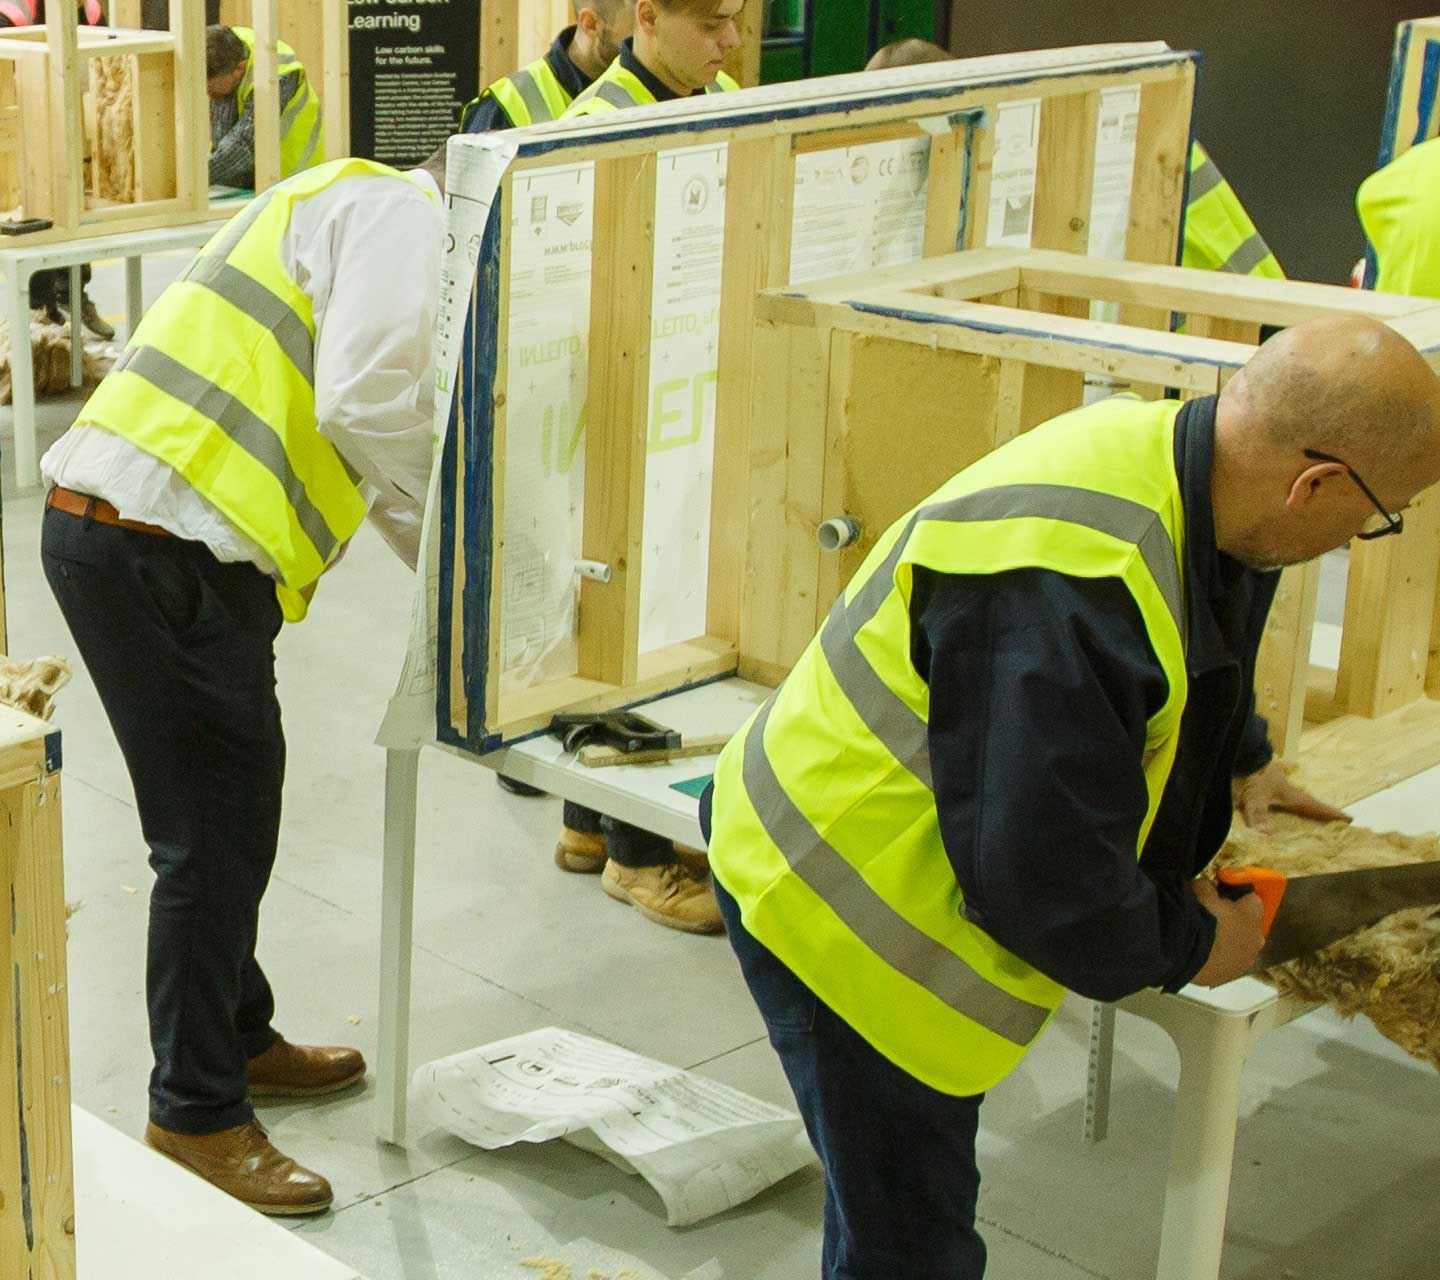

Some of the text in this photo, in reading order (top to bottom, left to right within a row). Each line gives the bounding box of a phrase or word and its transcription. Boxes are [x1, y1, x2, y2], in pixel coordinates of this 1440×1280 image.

[375, 45, 445, 55] Low carbon skills
[375, 55, 433, 65] for the future.
